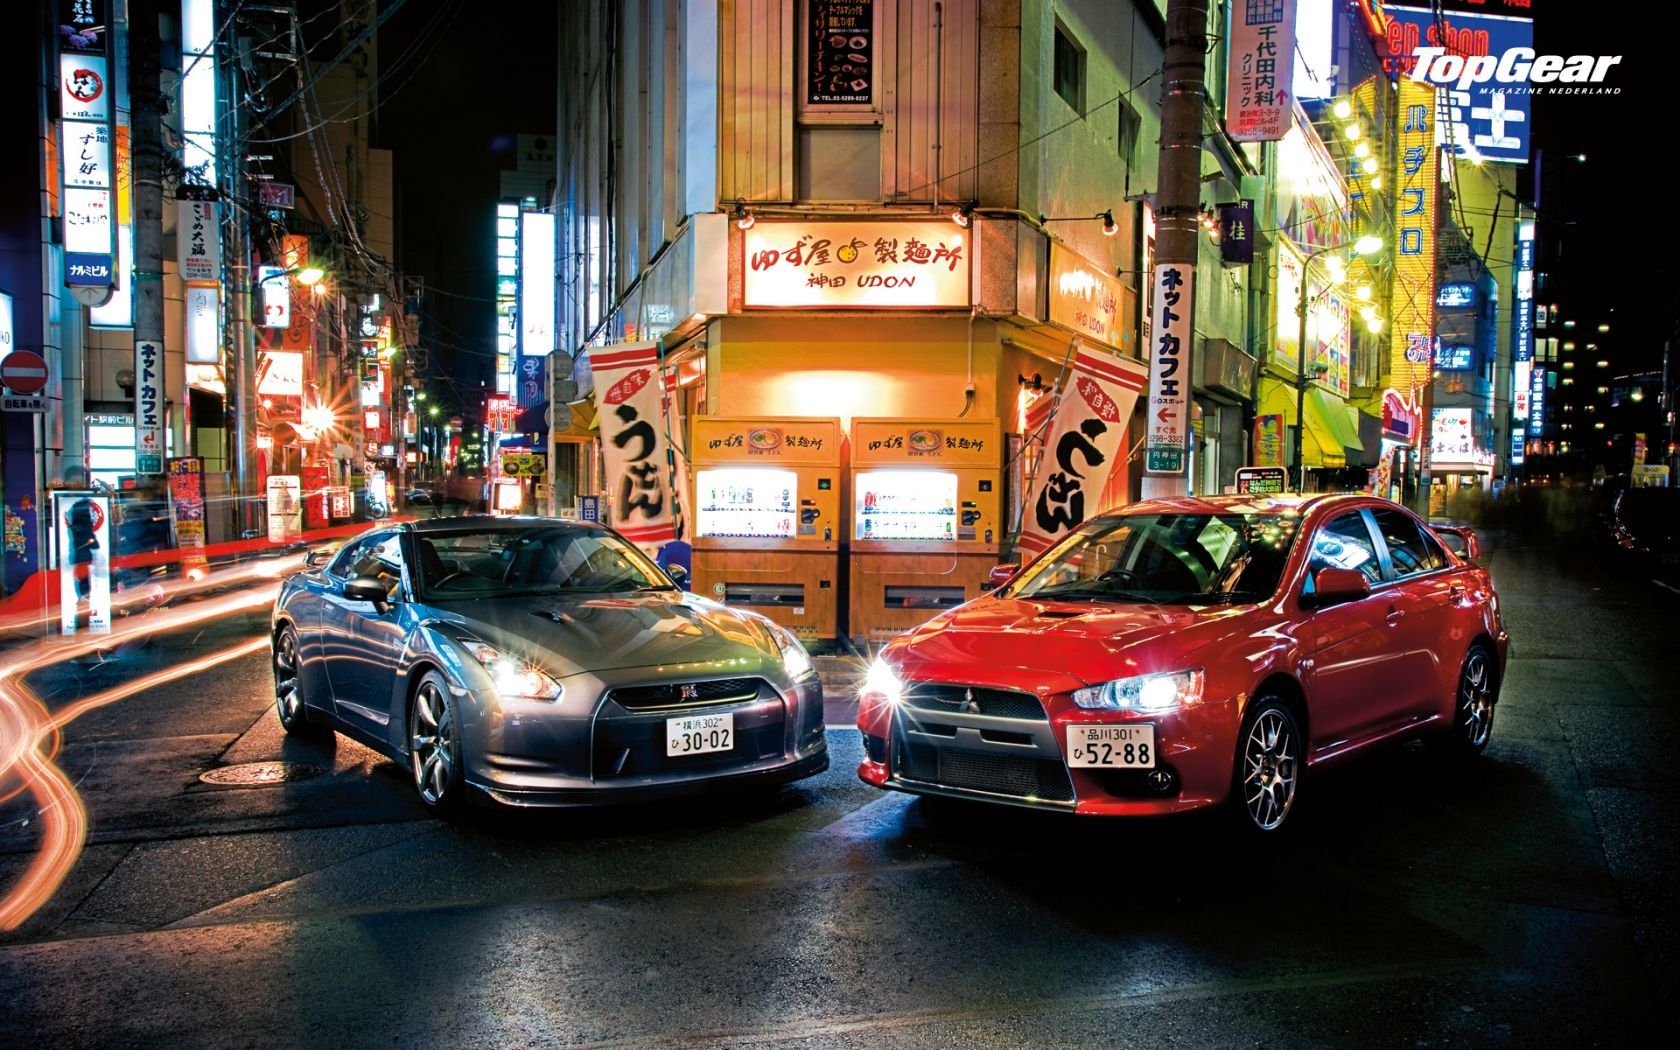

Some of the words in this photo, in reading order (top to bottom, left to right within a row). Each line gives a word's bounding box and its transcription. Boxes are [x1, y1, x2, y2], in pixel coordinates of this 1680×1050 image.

[1254, 25, 1278, 107] 千代田内科
[1241, 53, 1253, 107] クリニック
[1401, 105, 1428, 255] パチスロ
[1230, 220, 1246, 240] 桂
[751, 235, 832, 271] ゆず屋
[70, 264, 108, 277] ナルミビル
[805, 273, 846, 288] 神田
[857, 275, 916, 288] UDON
[1089, 316, 1105, 335] UDON
[1158, 268, 1183, 396] ネットカフェ
[140, 344, 157, 425] ネットカフェ
[709, 433, 744, 449] ゆず屋
[868, 434, 903, 450] ゆず屋
[611, 404, 662, 523] うどん
[1153, 451, 1177, 460] 内神田
[671, 739, 680, 749] ひ
[682, 729, 729, 752] 30-02
[1074, 748, 1083, 759] ひ
[1086, 743, 1150, 765] 52-88
